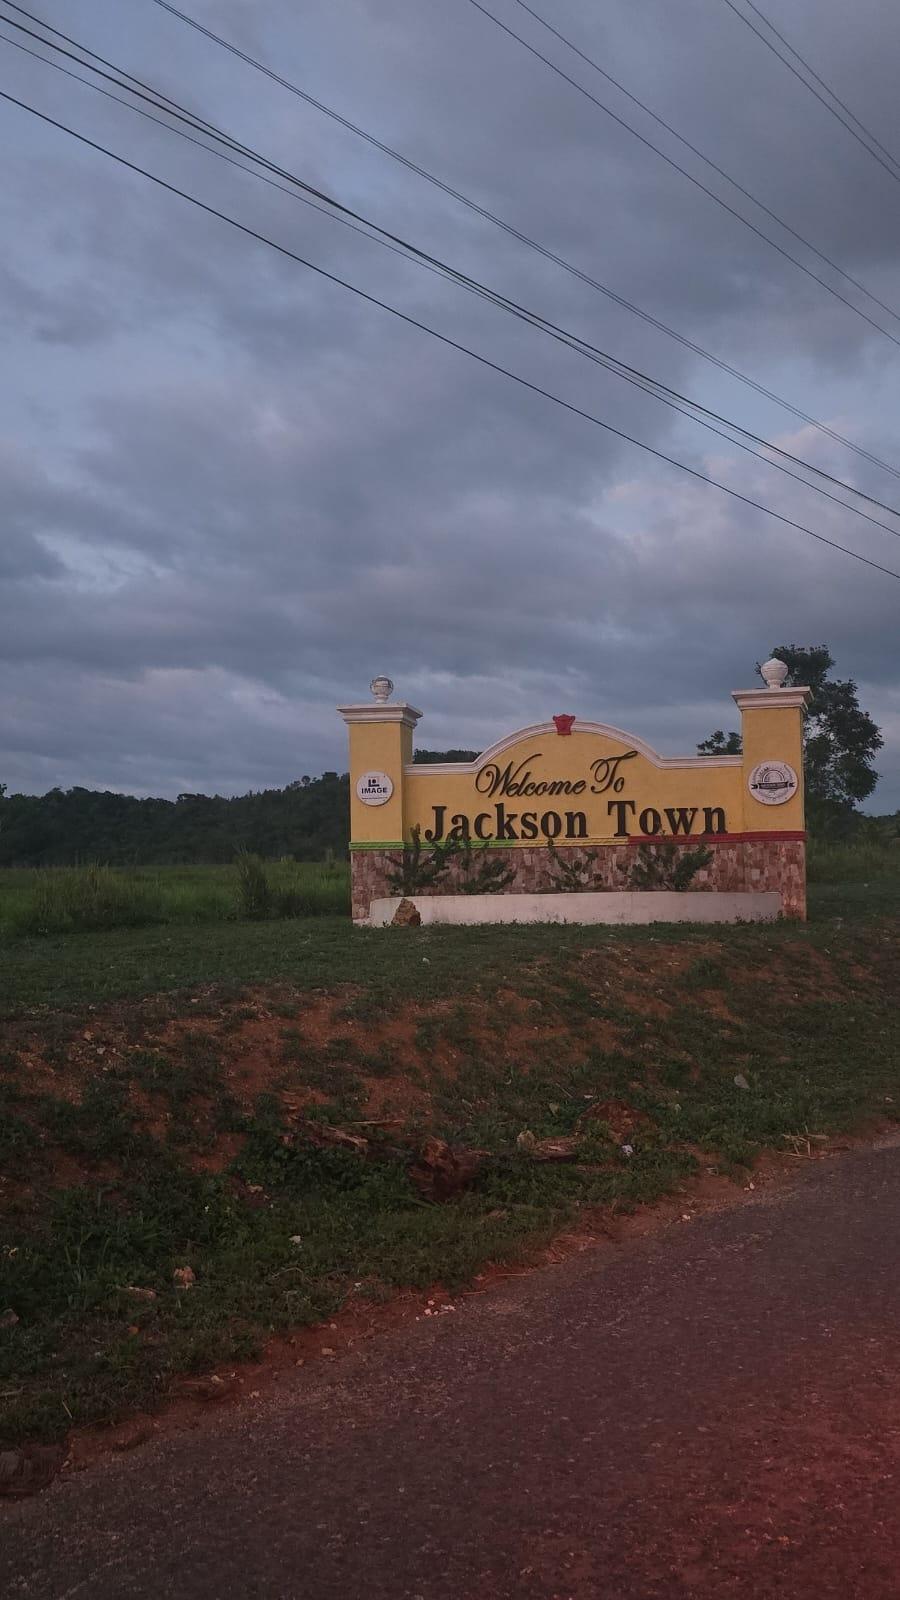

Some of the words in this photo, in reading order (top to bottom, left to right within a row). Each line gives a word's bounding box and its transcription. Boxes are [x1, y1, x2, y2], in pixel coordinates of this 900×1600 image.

[475, 753, 587, 798] Welcome
[590, 750, 638, 794] To
[425, 803, 588, 840] Jackson
[607, 800, 728, 837] Town
